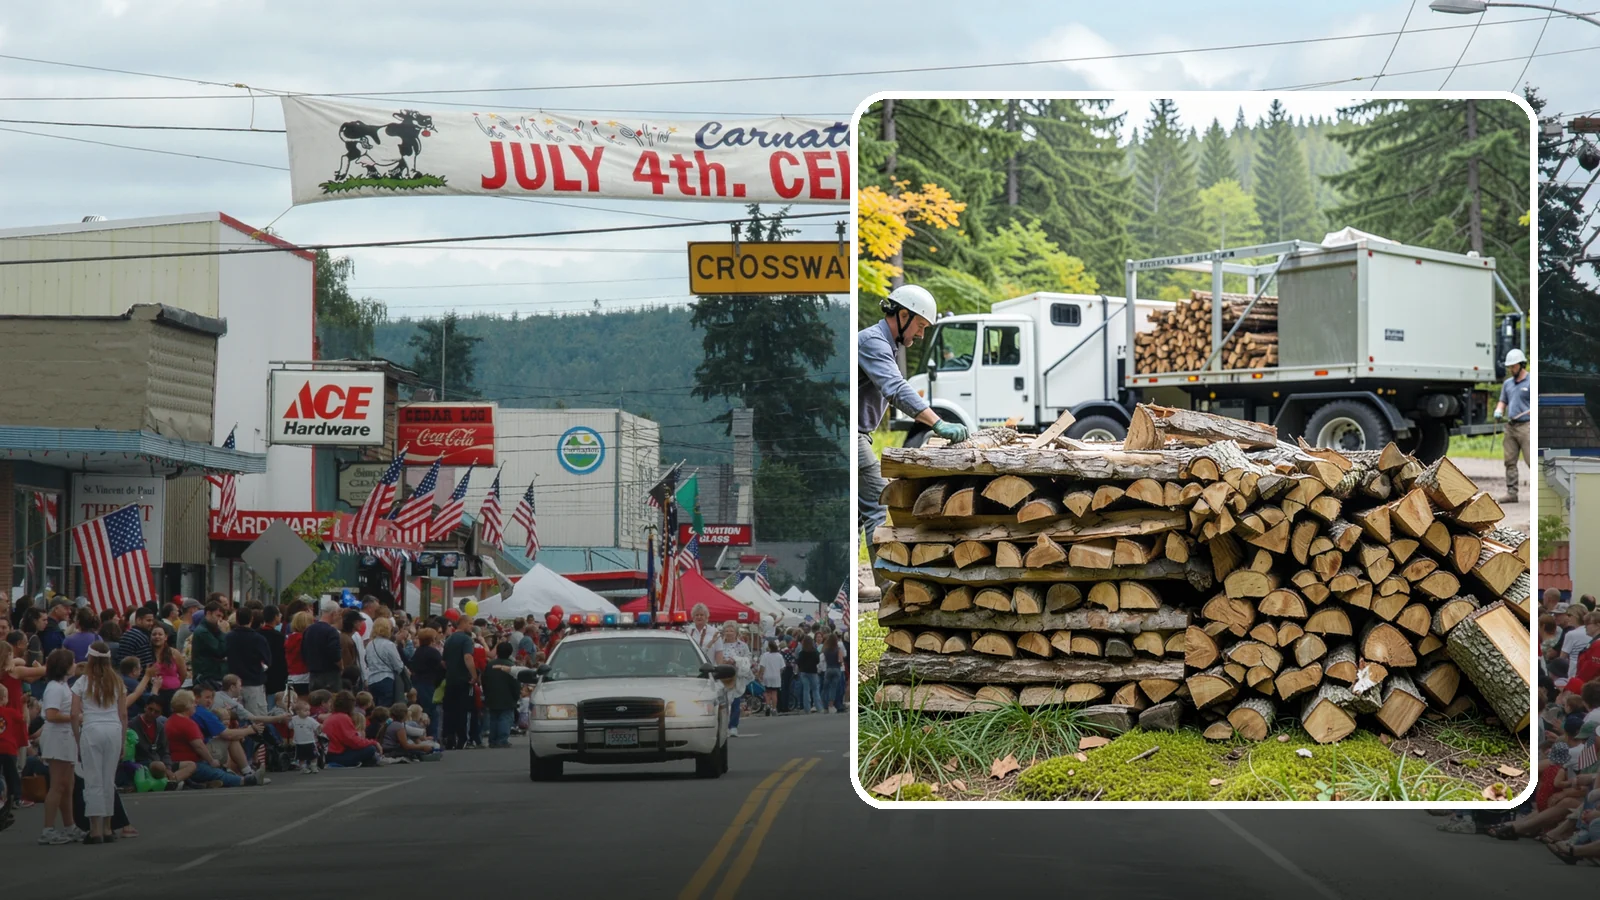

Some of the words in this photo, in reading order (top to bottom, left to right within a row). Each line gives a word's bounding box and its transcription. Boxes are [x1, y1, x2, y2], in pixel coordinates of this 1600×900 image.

[481, 141, 605, 192] JULY
[632, 150, 746, 197] 4th.
[697, 254, 850, 279] CROSSWA
[283, 380, 373, 420] ACE
[406, 409, 452, 422] CEDAR
[461, 409, 485, 421] LOG
[283, 421, 371, 436] Hardware
[354, 467, 385, 480] Simpl
[96, 485, 124, 494] Vincent
[126, 486, 136, 494] de
[138, 486, 155, 495] Paul
[688, 526, 741, 535] CRNATION
[699, 535, 730, 543] GLASS
